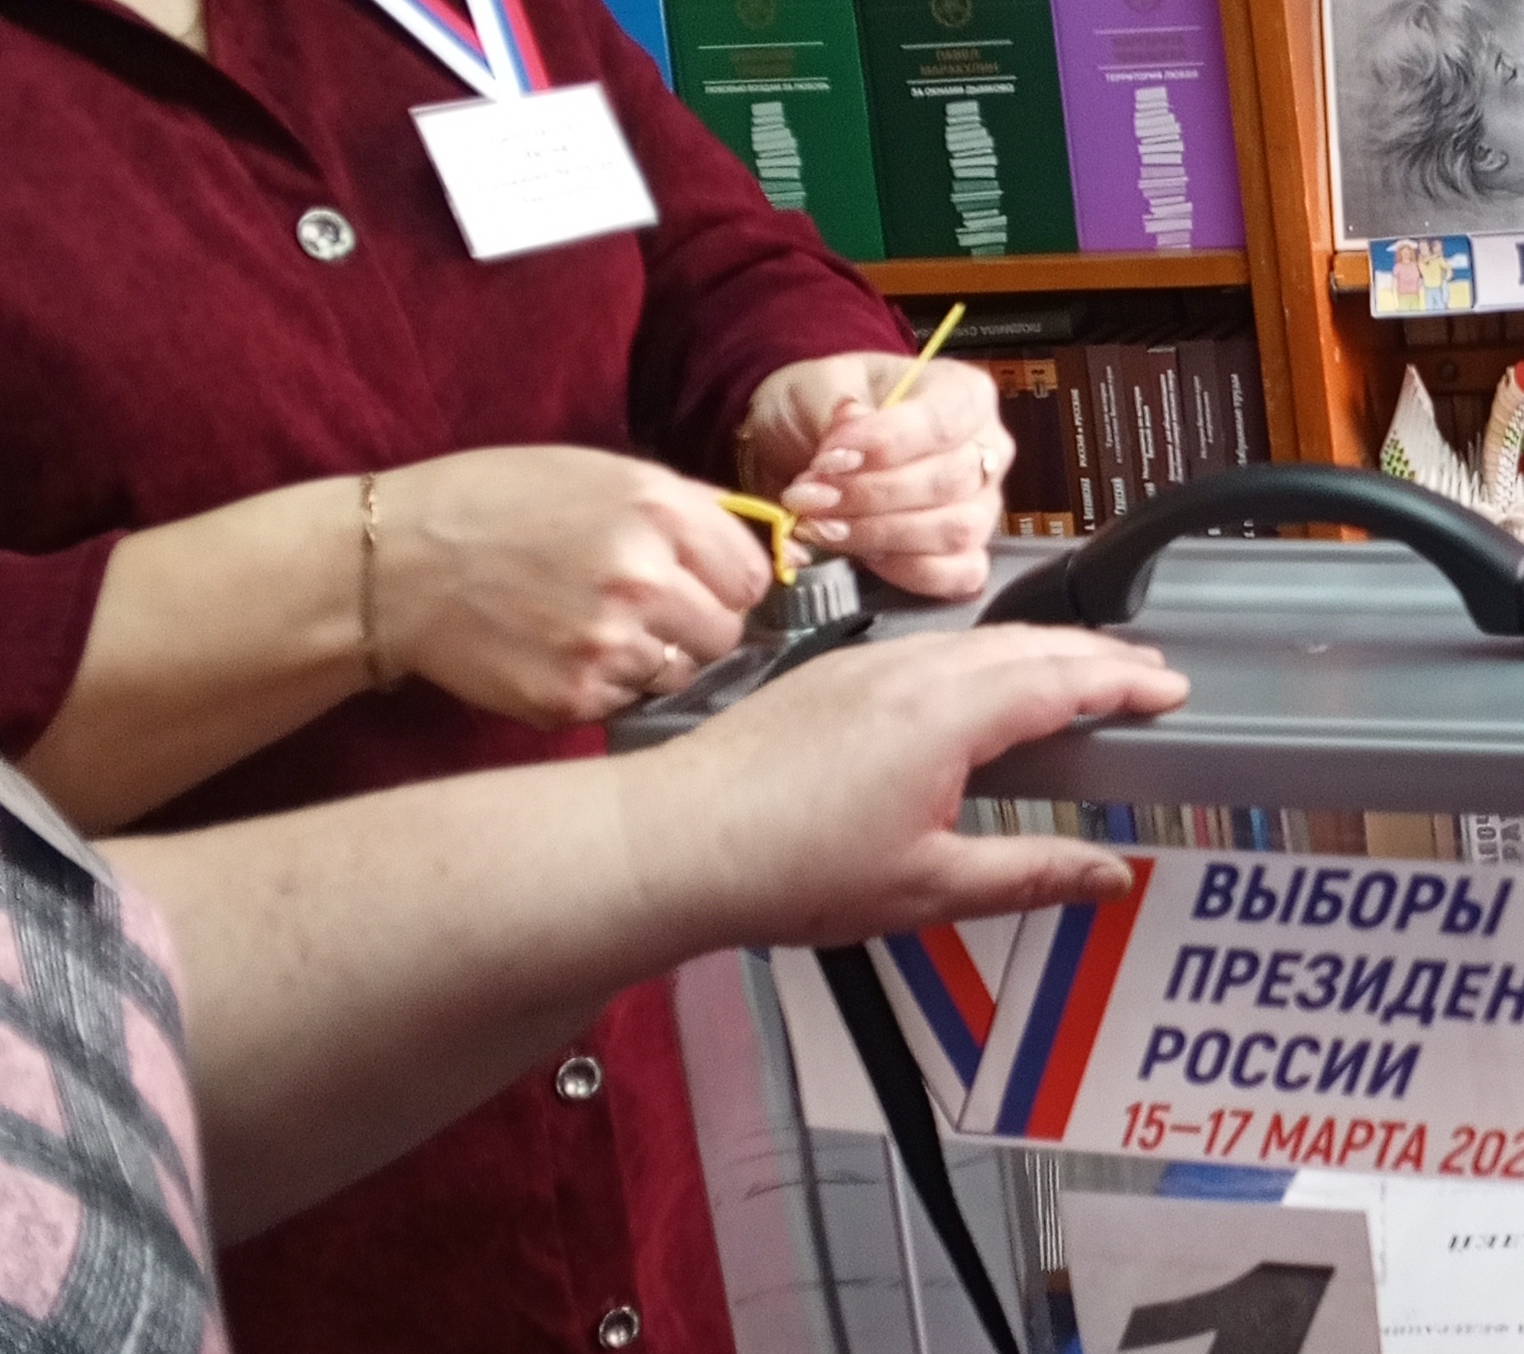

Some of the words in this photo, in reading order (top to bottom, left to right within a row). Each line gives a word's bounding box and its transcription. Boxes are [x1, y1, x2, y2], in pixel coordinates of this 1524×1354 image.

[1191, 861, 1514, 939] ВЫБОРЫ
[1137, 1025, 1422, 1100] РОССИИ
[1258, 1112, 1428, 1174] МАРТА
